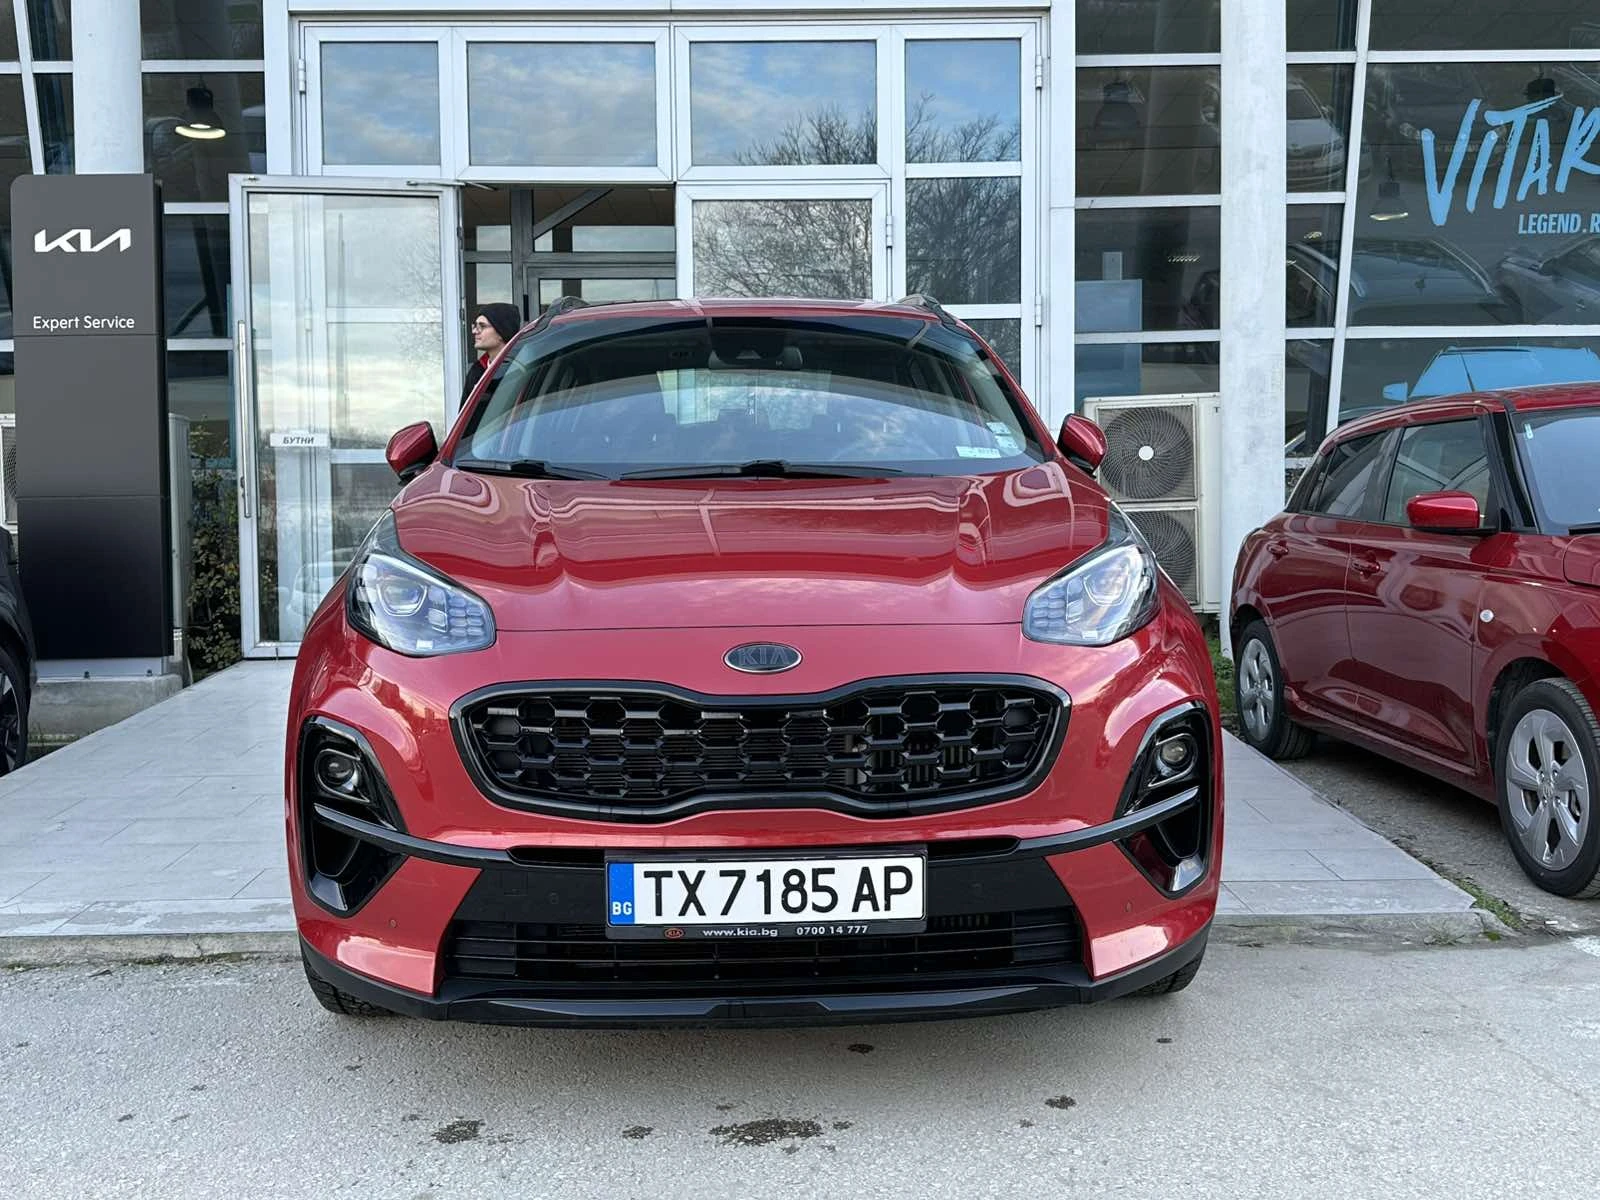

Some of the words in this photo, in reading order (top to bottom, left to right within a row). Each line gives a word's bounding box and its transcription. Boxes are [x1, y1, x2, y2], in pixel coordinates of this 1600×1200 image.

[34, 228, 131, 252] KIA
[33, 316, 80, 332] Expert
[83, 315, 135, 329] Service
[282, 436, 315, 445] БУТНИ
[734, 645, 792, 667] KIA
[643, 870, 706, 917] TX
[719, 867, 839, 916] 7185
[851, 865, 913, 913] AP
[612, 901, 633, 916] BG
[665, 929, 683, 938] KIA
[702, 927, 778, 937] www.kia.bg
[796, 926, 826, 936] 0700
[829, 925, 844, 935] 14
[847, 925, 868, 934] 777
